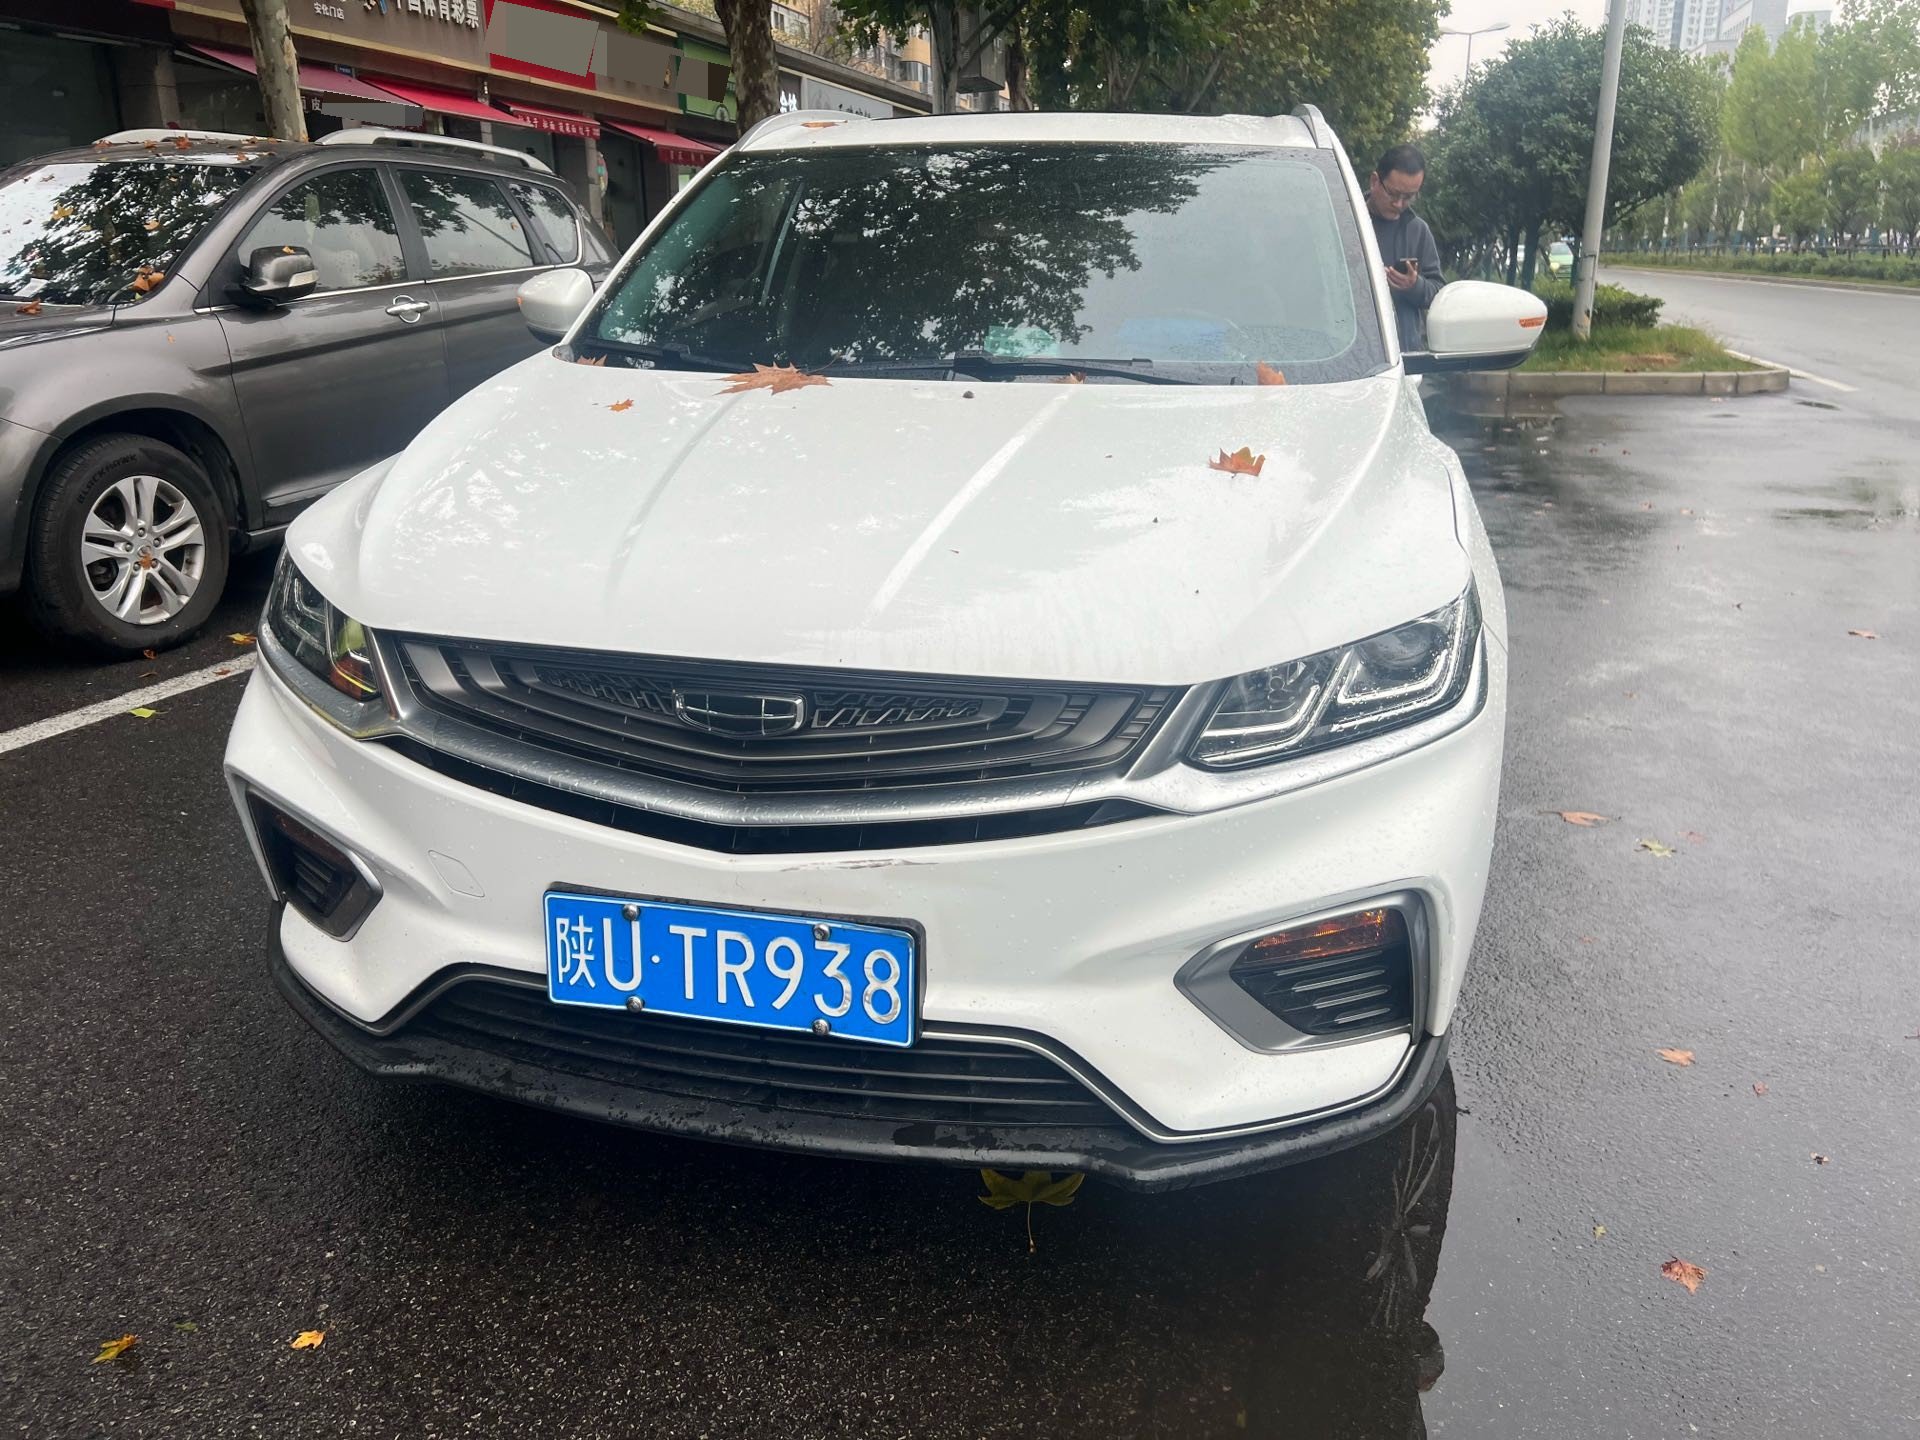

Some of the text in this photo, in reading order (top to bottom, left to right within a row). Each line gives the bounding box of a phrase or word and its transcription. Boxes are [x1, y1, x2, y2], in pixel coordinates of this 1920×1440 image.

[313, 2, 345, 20] 安化门店
[396, 0, 479, 29] 体育彩票
[556, 914, 902, 1025] 陕U·TR938
